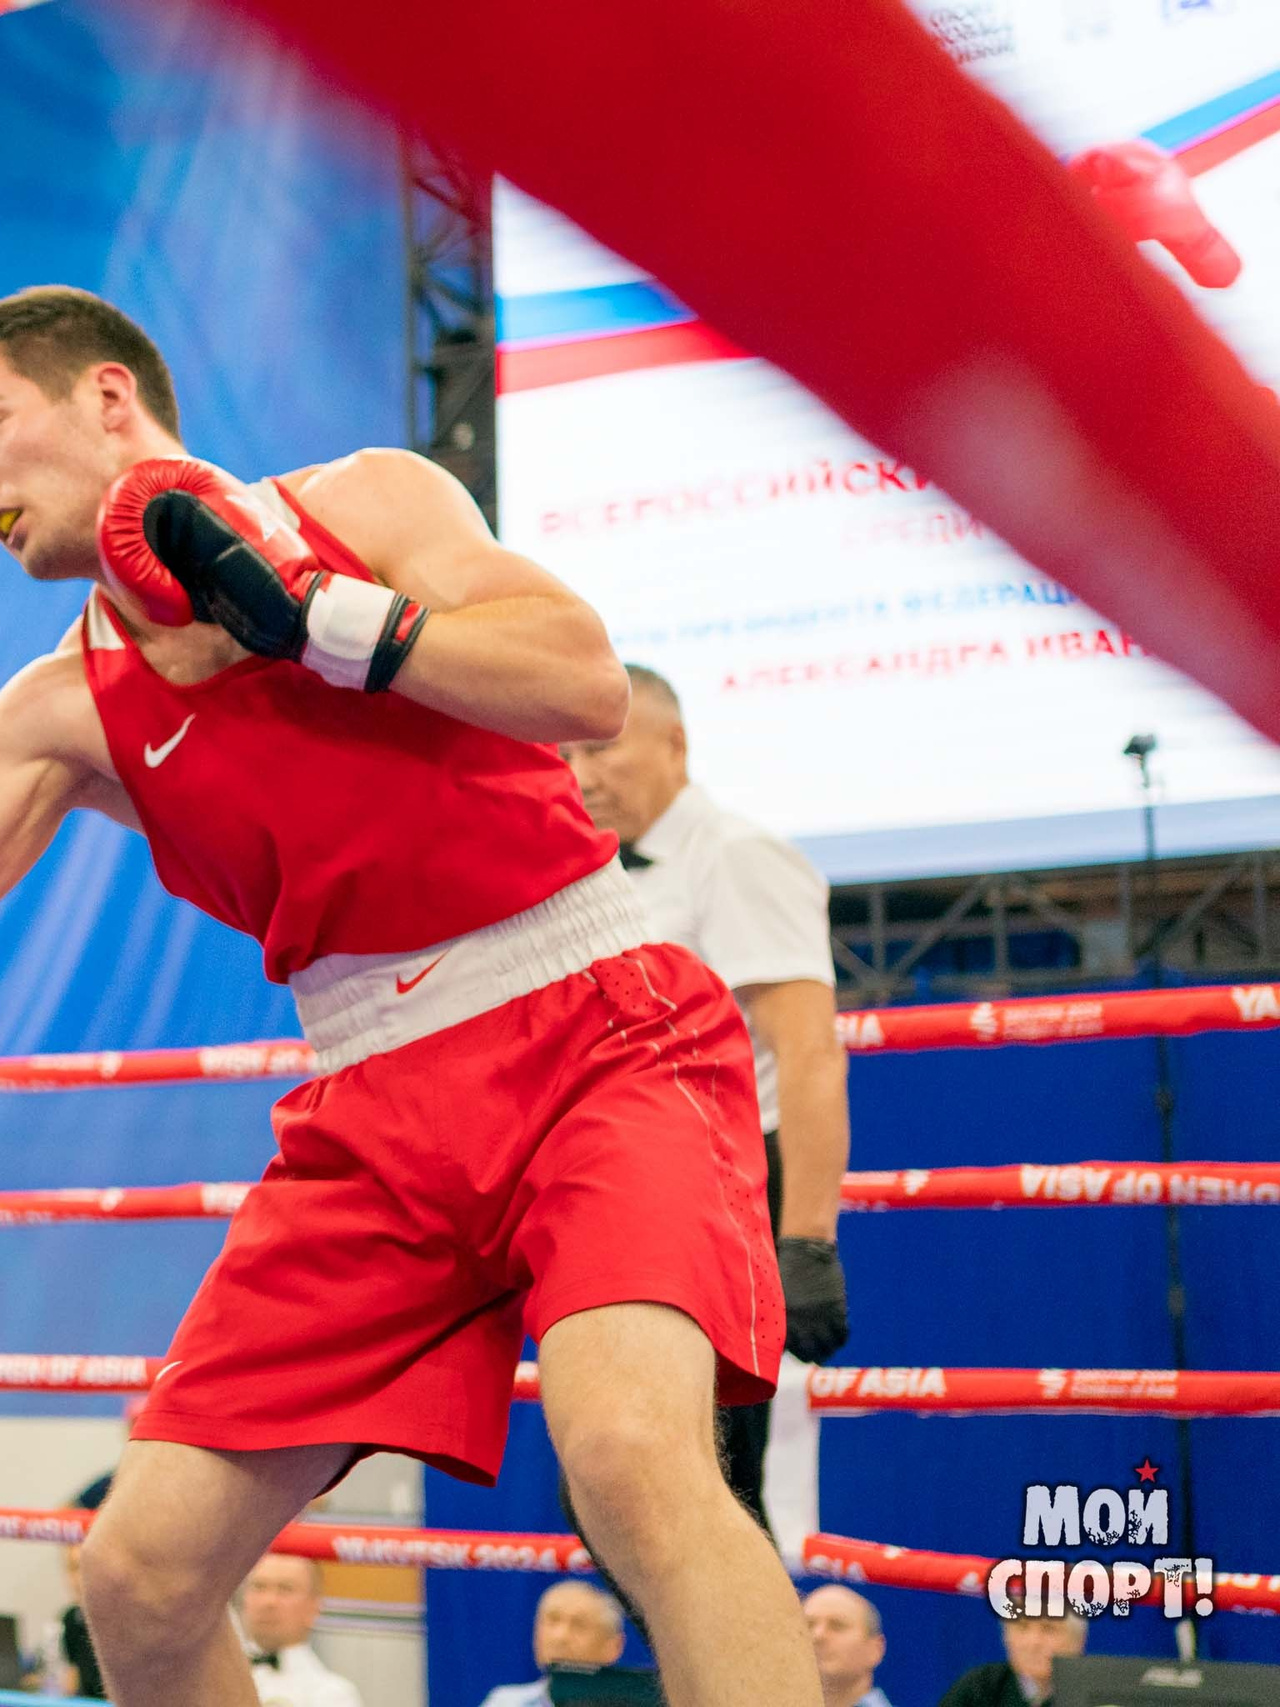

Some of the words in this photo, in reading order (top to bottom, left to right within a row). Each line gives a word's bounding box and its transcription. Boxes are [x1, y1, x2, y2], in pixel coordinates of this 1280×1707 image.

[1021, 1164, 1111, 1201] ASIA
[811, 1367, 861, 1397] OF
[857, 1367, 947, 1397] ASIA
